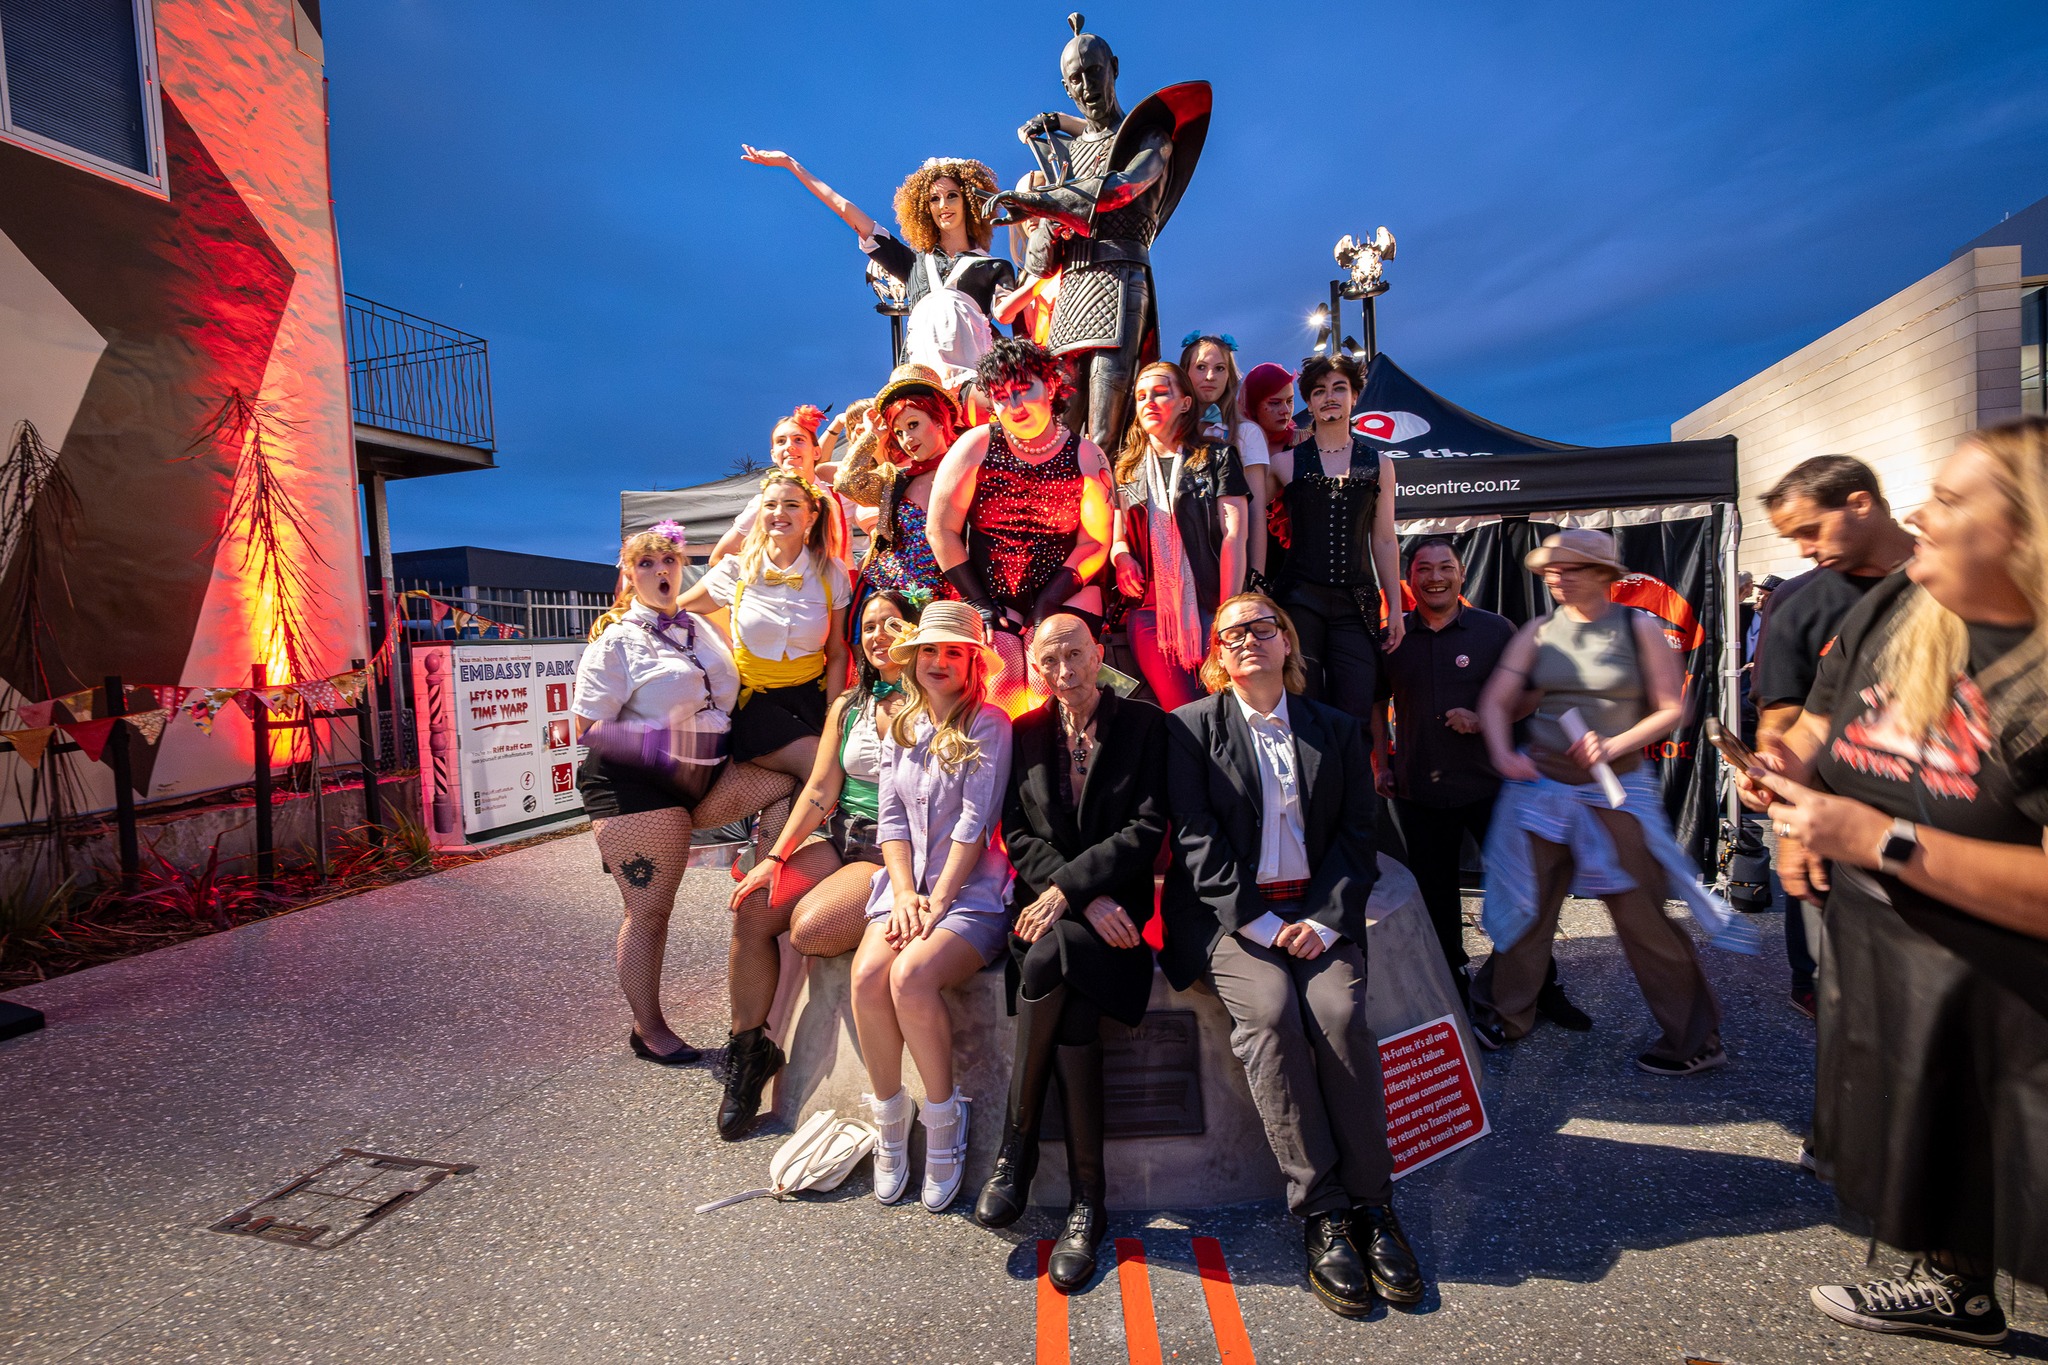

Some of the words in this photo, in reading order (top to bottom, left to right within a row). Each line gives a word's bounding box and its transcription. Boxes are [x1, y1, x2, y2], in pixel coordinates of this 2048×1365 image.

[1395, 479, 1521, 497] hecentre.co.nz
[460, 662, 532, 682] EMBASSY
[535, 660, 575, 678] PARK
[469, 689, 493, 704] LET'S
[495, 688, 509, 700] DO
[511, 687, 527, 700] THE
[471, 704, 497, 720] TIME
[499, 702, 528, 719] WARP
[492, 745, 505, 753] Riff
[505, 743, 519, 751] Raff
[1381, 1044, 1415, 1063] -N-Furter,
[1413, 1038, 1426, 1050] it's
[1425, 1033, 1435, 1046] all
[1433, 1030, 1449, 1042] over
[1383, 1062, 1411, 1079] mission
[1410, 1058, 1418, 1068] is
[1421, 1048, 1445, 1063] failure
[1387, 1073, 1421, 1094] lifestyle's
[1420, 1069, 1433, 1080] too
[1433, 1058, 1461, 1075] extreme
[1387, 1099, 1404, 1114] your
[1405, 1091, 1420, 1105] new
[1420, 1074, 1459, 1098] commander
[1394, 1113, 1411, 1127] now
[1410, 1108, 1423, 1119] are
[1422, 1102, 1435, 1114] my
[1434, 1090, 1462, 1111] prisoner
[1397, 1126, 1421, 1144] return
[1420, 1122, 1429, 1133] to
[1427, 1102, 1471, 1128] Transylvania
[1393, 1145, 1419, 1162] repare
[1417, 1138, 1432, 1151] the
[1430, 1126, 1455, 1145] transit
[1452, 1119, 1473, 1134] beam
